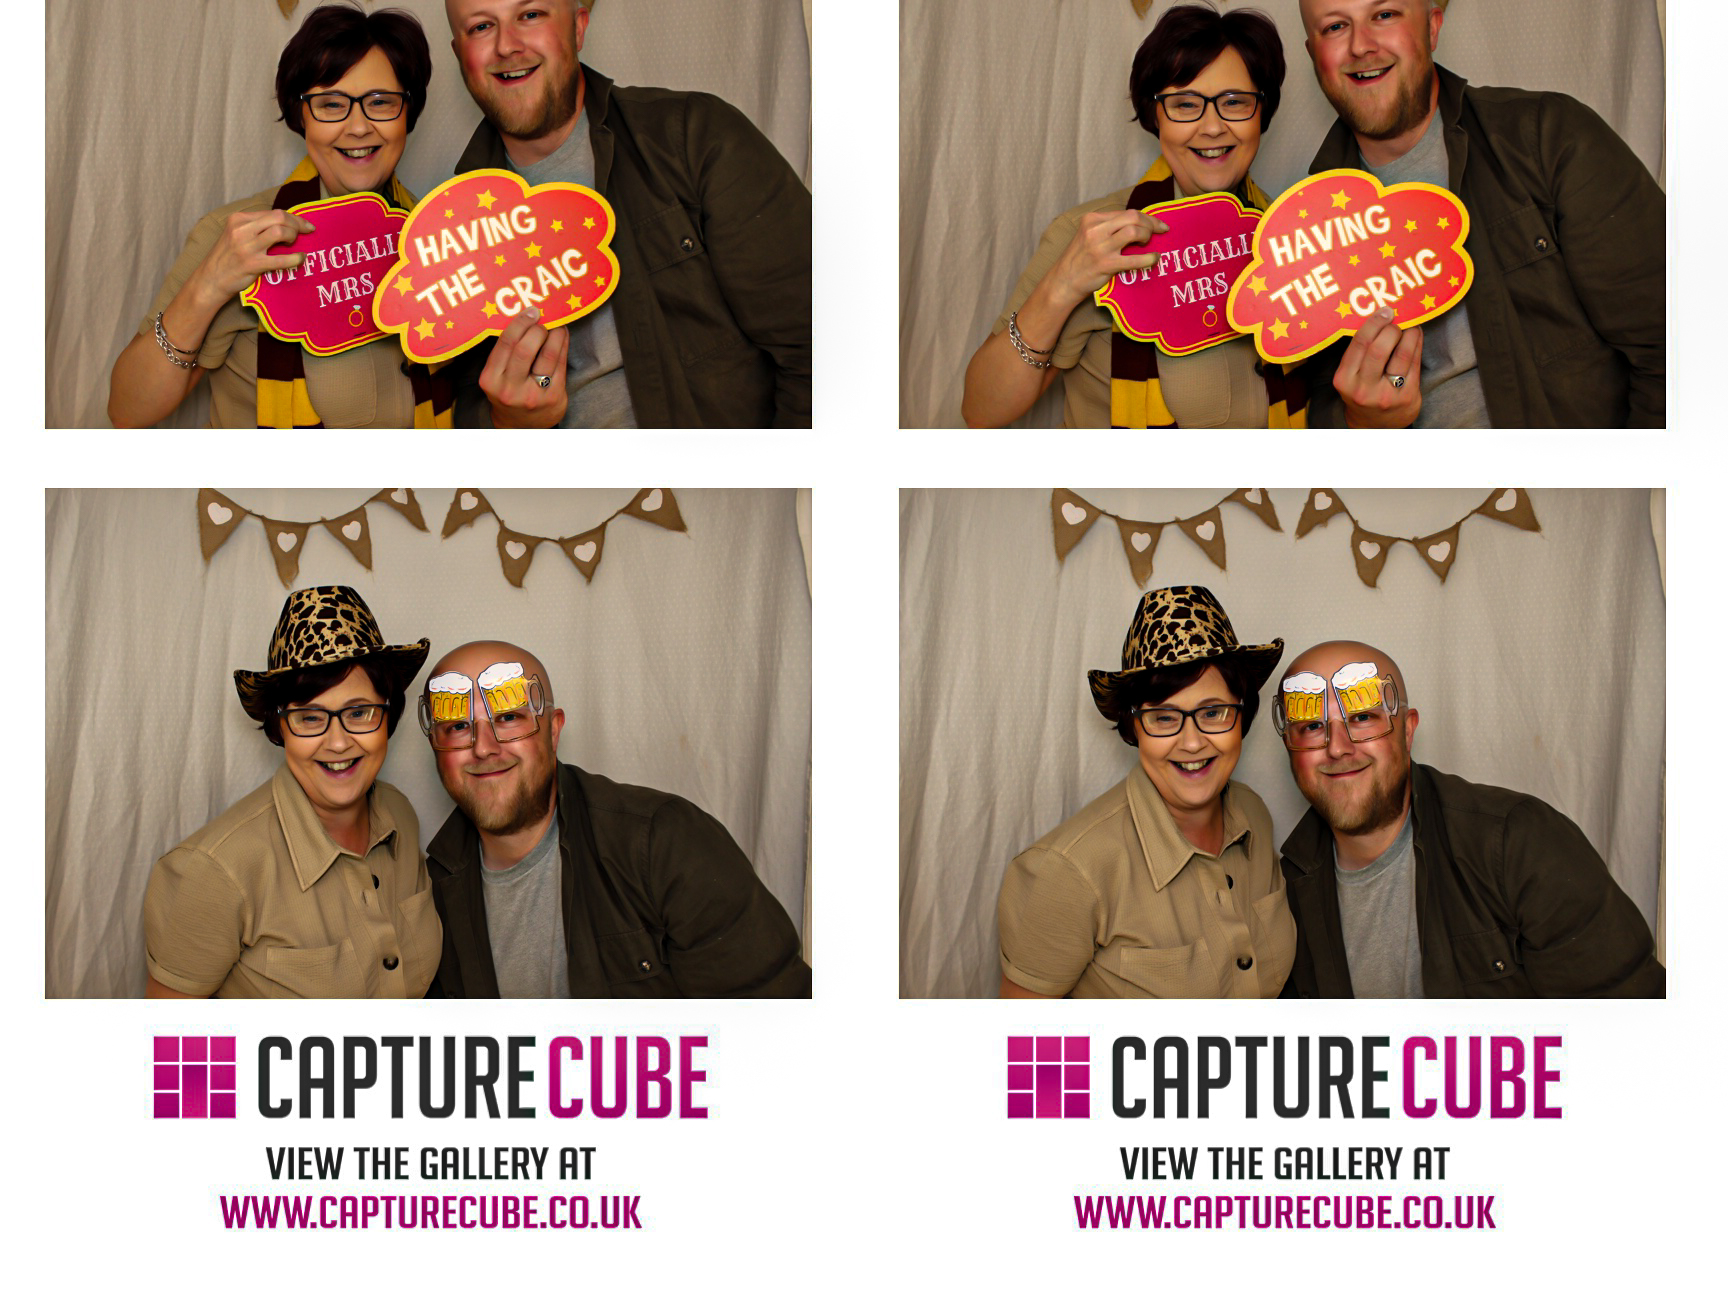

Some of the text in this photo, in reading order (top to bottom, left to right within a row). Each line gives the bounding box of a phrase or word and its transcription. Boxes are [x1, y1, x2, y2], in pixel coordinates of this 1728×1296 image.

[413, 205, 537, 267] HAVING
[1267, 205, 1391, 267] HAVING
[316, 271, 375, 308] MRS
[415, 262, 487, 317] THE
[494, 248, 588, 317] CRAIC
[1170, 271, 1229, 308] MRS
[1269, 262, 1341, 317] THE
[1348, 248, 1442, 317] CRAIC
